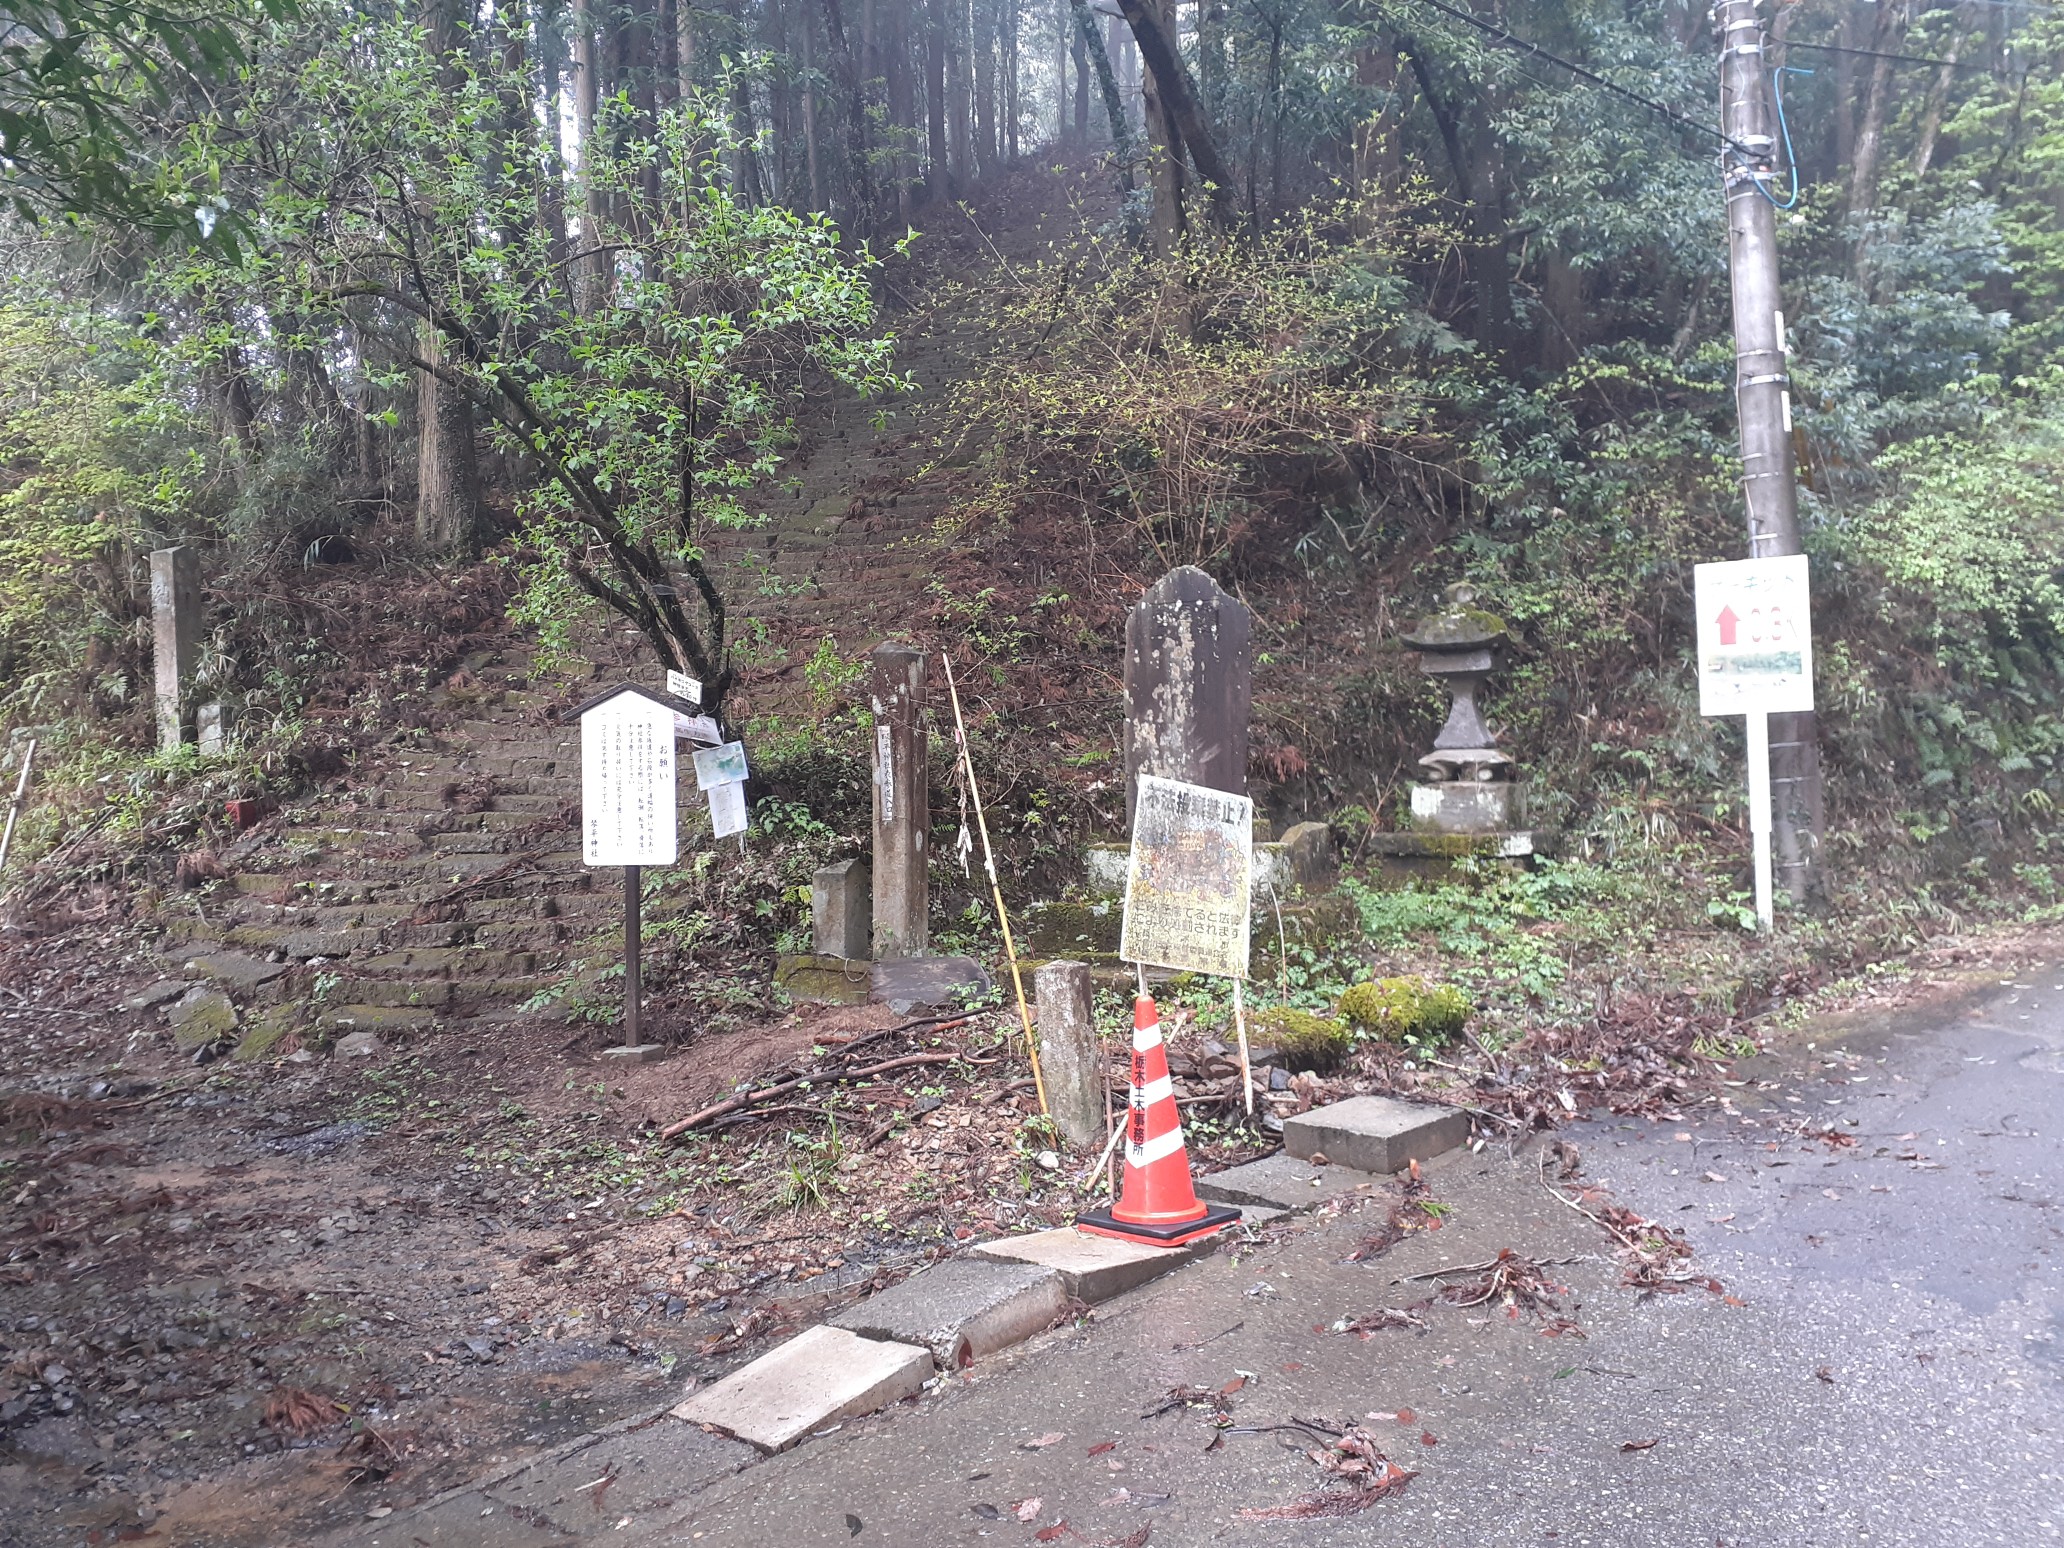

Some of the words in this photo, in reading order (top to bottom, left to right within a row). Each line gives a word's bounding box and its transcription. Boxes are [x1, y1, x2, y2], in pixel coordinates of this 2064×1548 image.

[659, 744, 669, 780] お願い
[590, 819, 598, 858] 琴平神社
[1132, 1056, 1146, 1157] 栃木土木事務所
